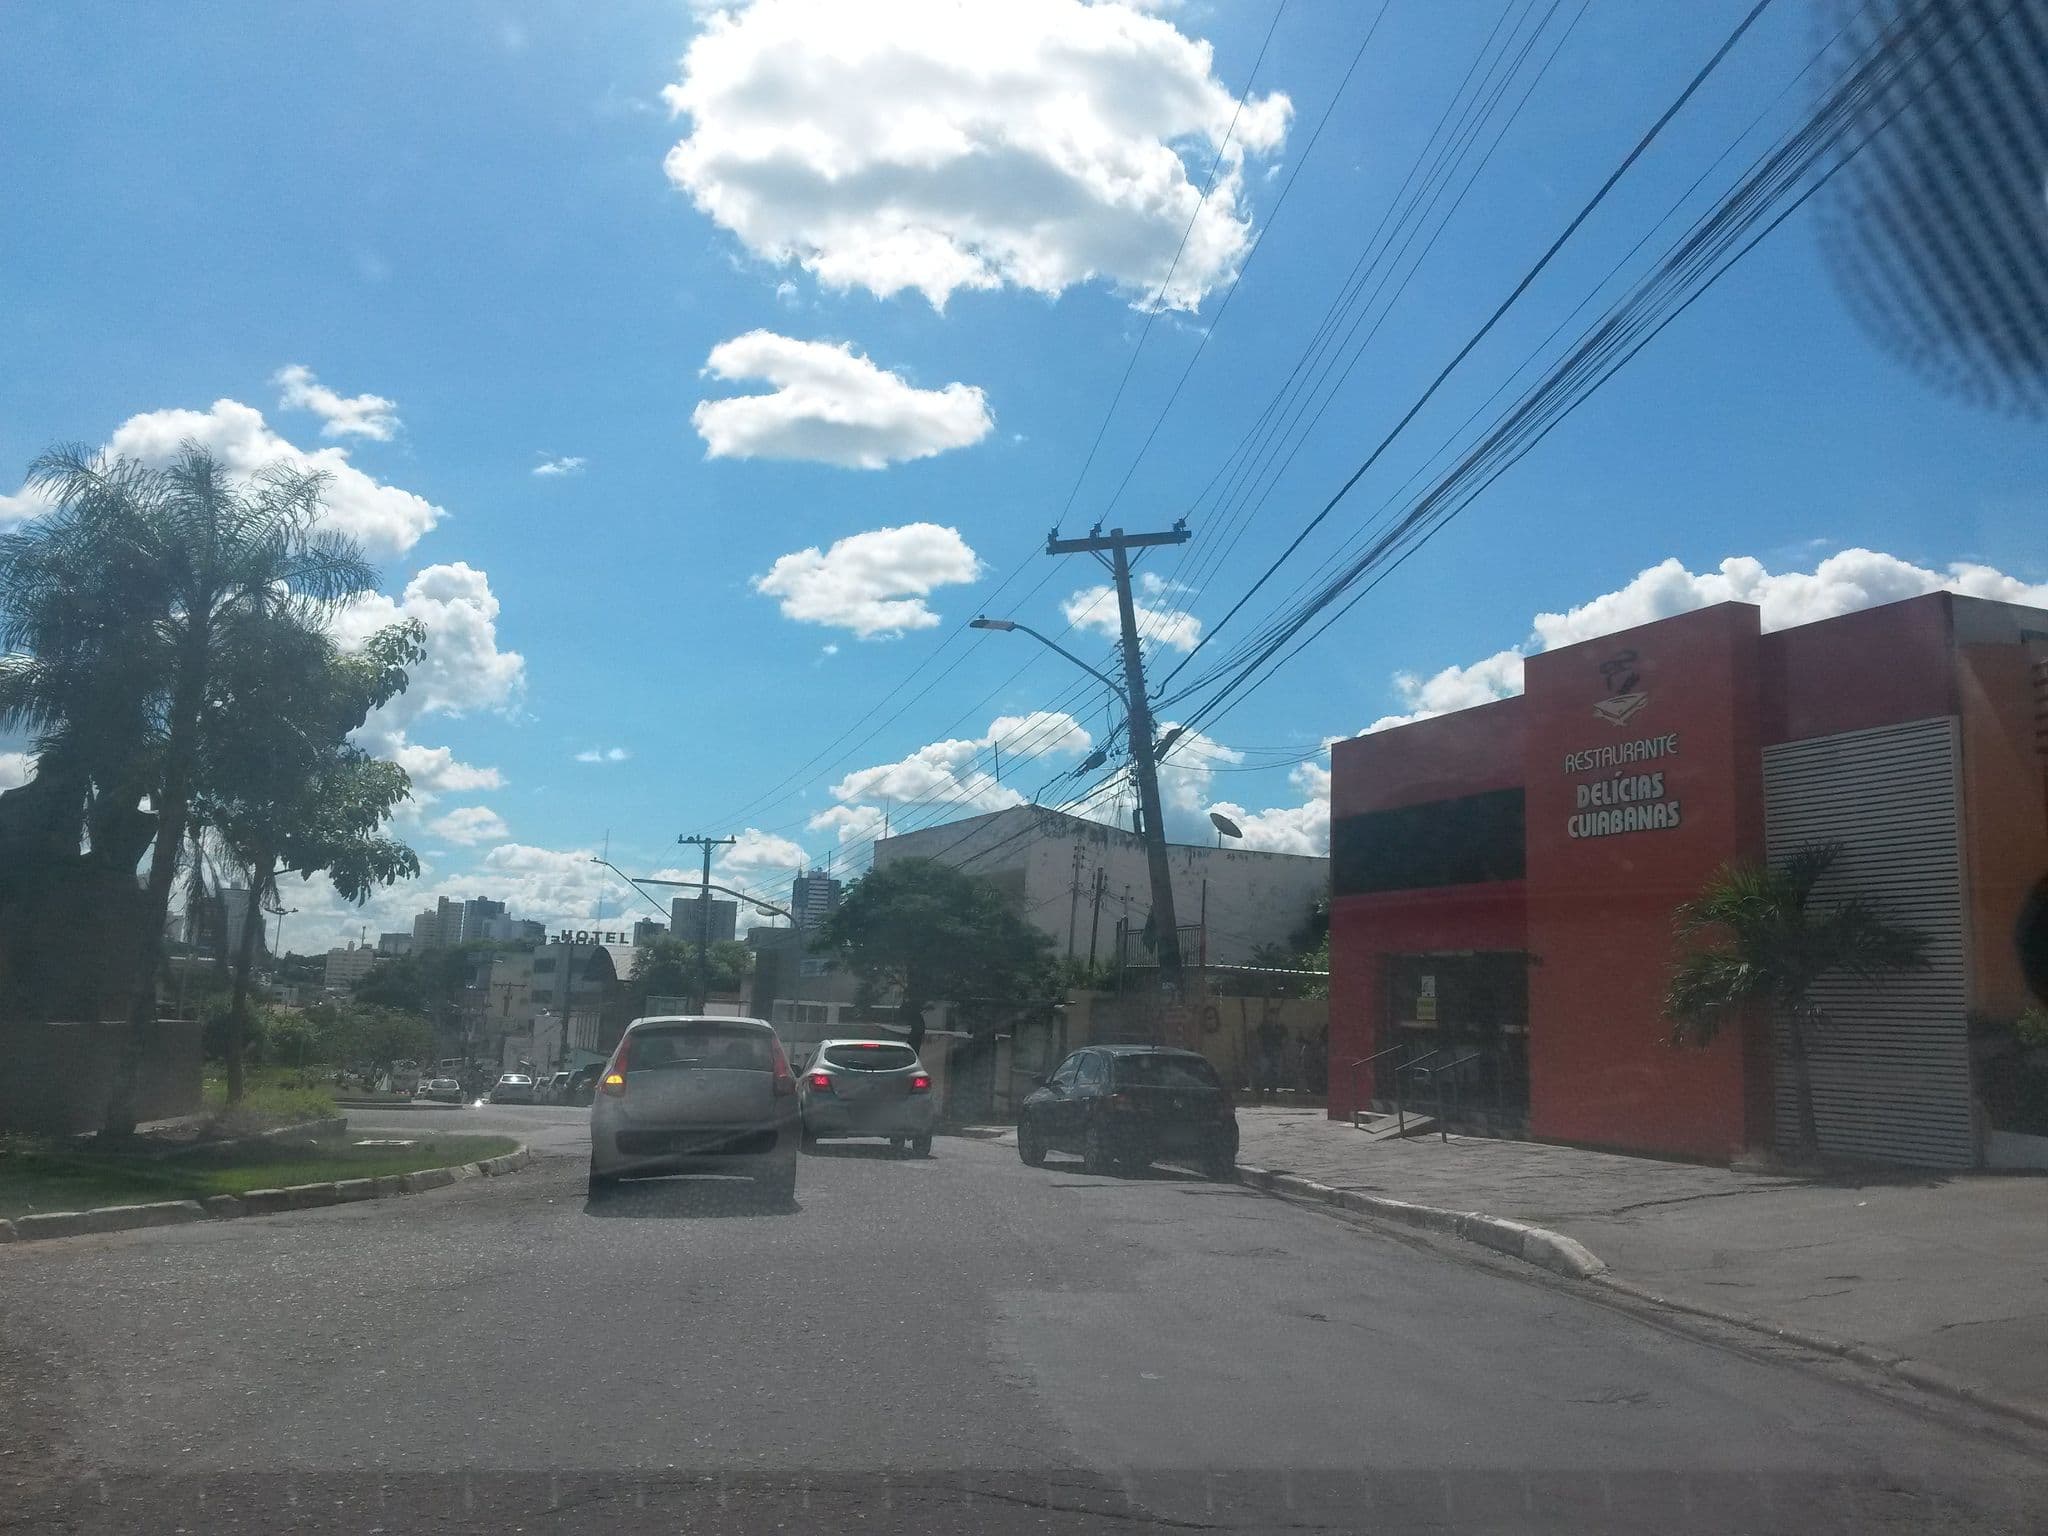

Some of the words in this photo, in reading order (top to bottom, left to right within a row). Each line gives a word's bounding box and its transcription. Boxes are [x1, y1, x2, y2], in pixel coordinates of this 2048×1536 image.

[1564, 733, 1678, 774] RESTAURANTE
[1576, 771, 1665, 808] DELÍCIAS
[1566, 801, 1682, 838] CUIABANAS
[560, 929, 630, 945] HOTEL
